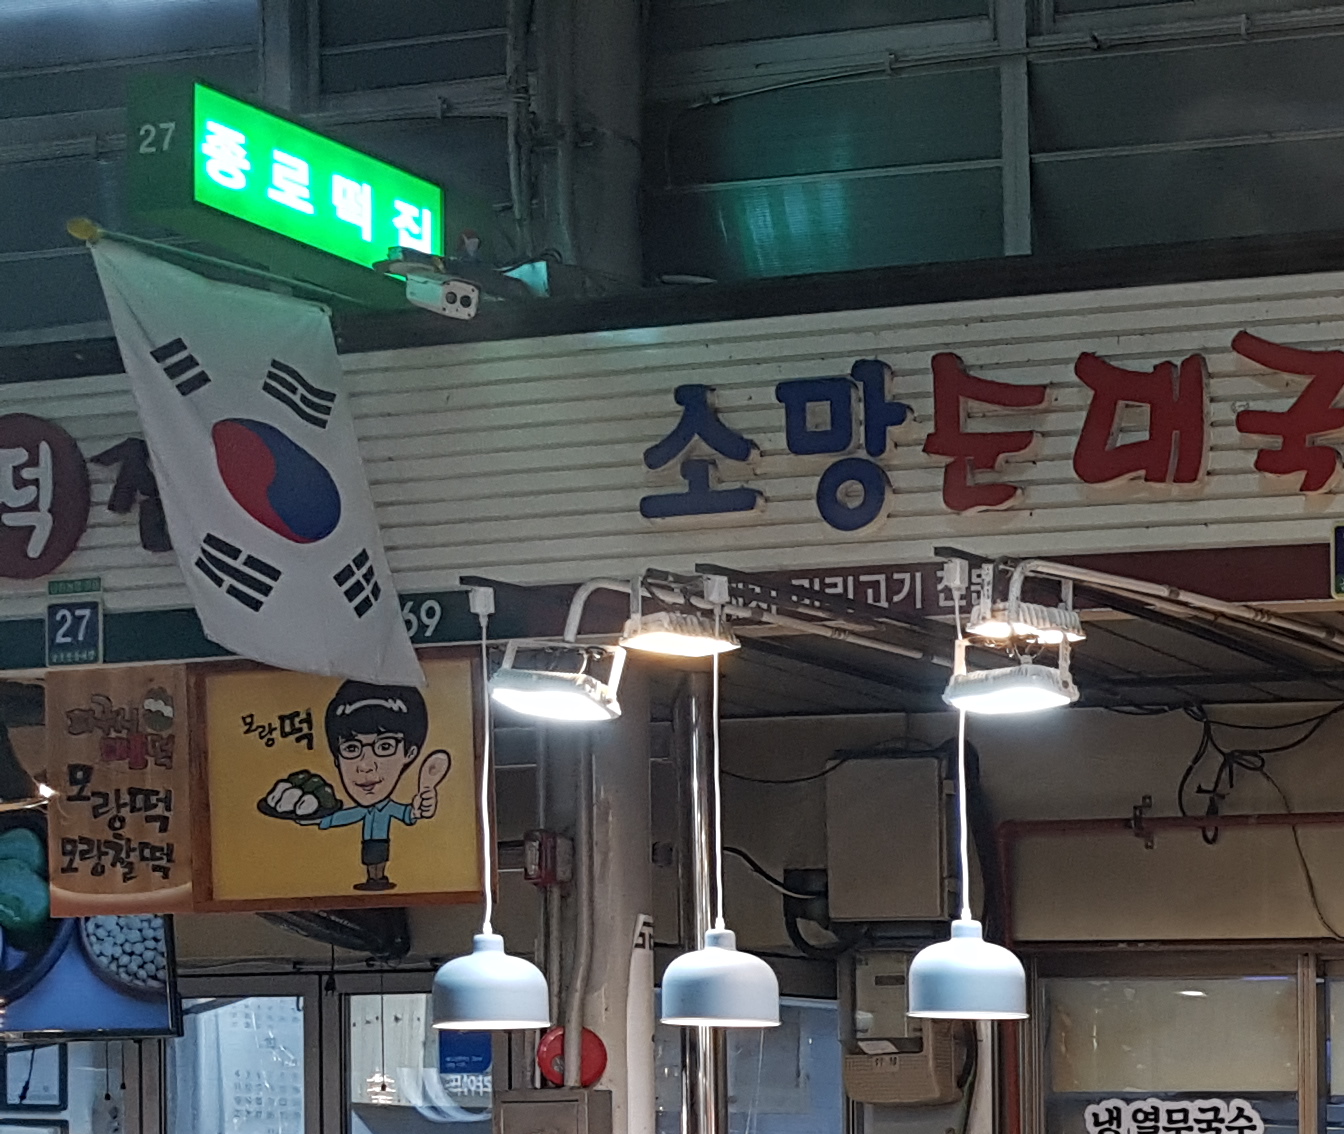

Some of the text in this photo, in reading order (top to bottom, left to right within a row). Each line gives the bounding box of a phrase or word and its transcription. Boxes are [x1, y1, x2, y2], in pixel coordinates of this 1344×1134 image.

[139, 122, 176, 154] 27
[55, 608, 91, 644] 27
[241, 706, 315, 751] 모랑떡
[66, 763, 173, 833] 모랑떡
[60, 832, 175, 884] 모랑찰떡
